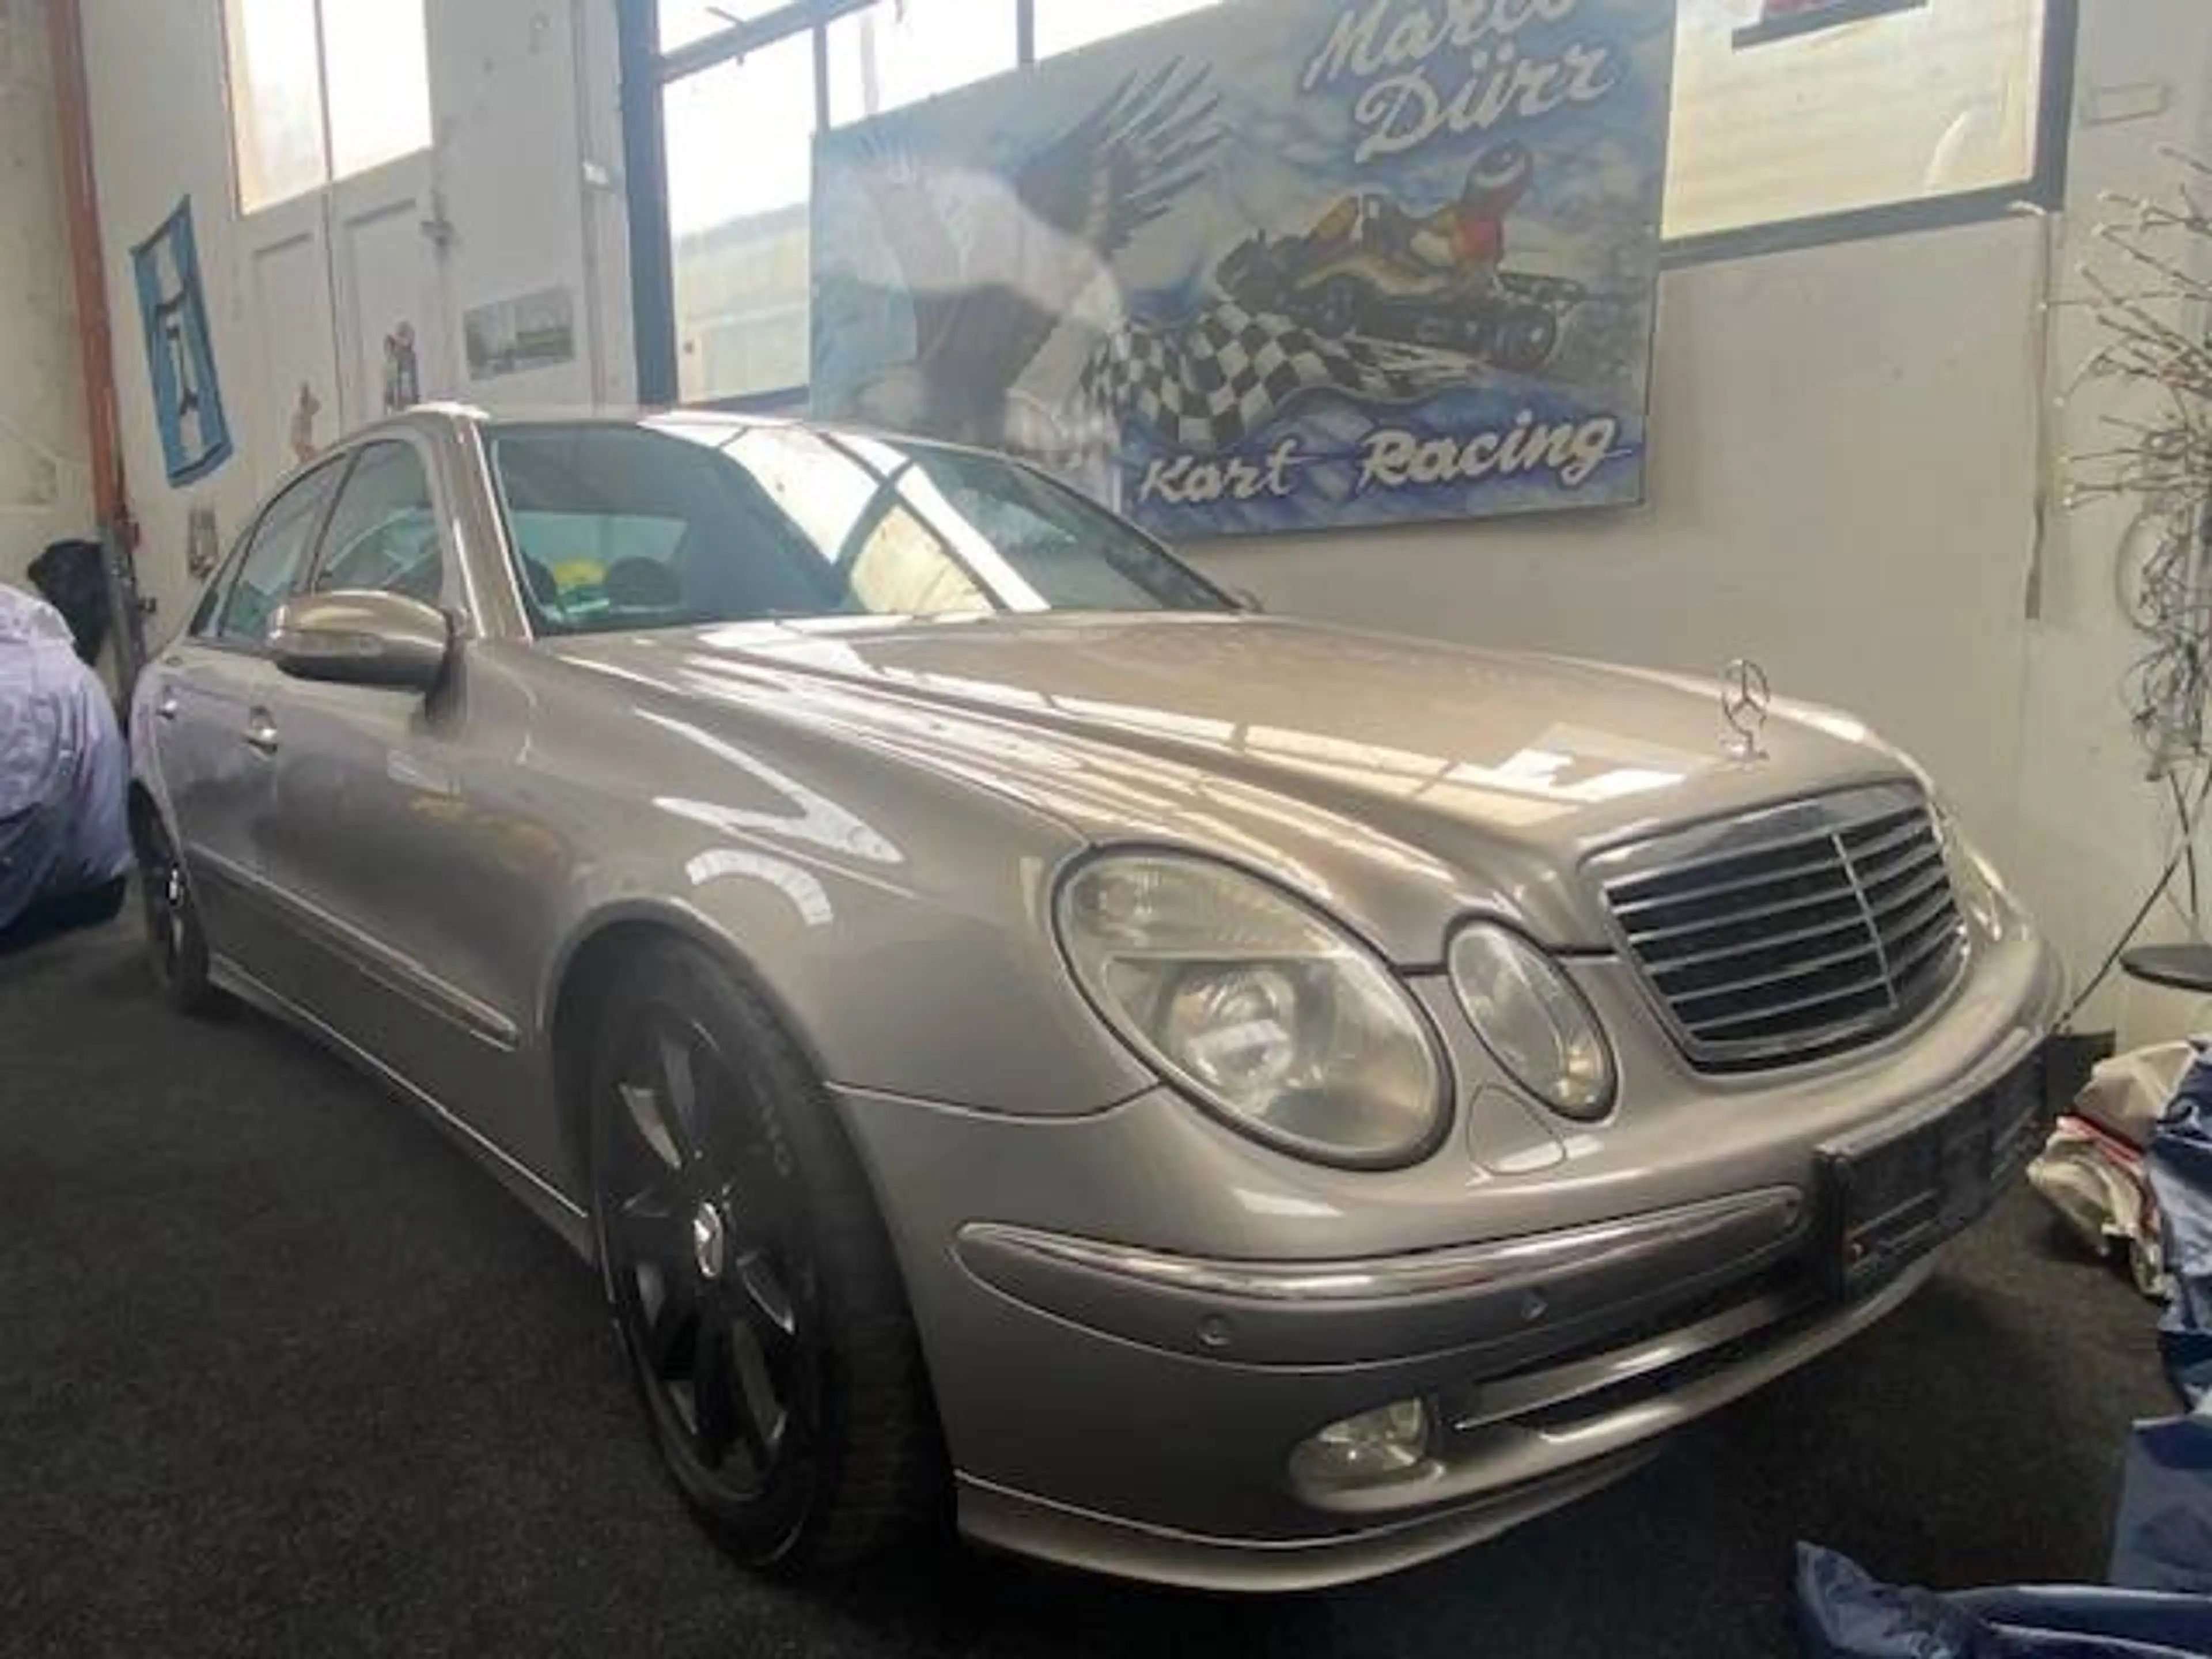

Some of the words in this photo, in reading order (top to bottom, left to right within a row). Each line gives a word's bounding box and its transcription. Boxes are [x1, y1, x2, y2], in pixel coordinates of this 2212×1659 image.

[1355, 43, 1615, 164] Dürr
[1138, 439, 1319, 503] Kart
[1355, 410, 1631, 488] Racing
